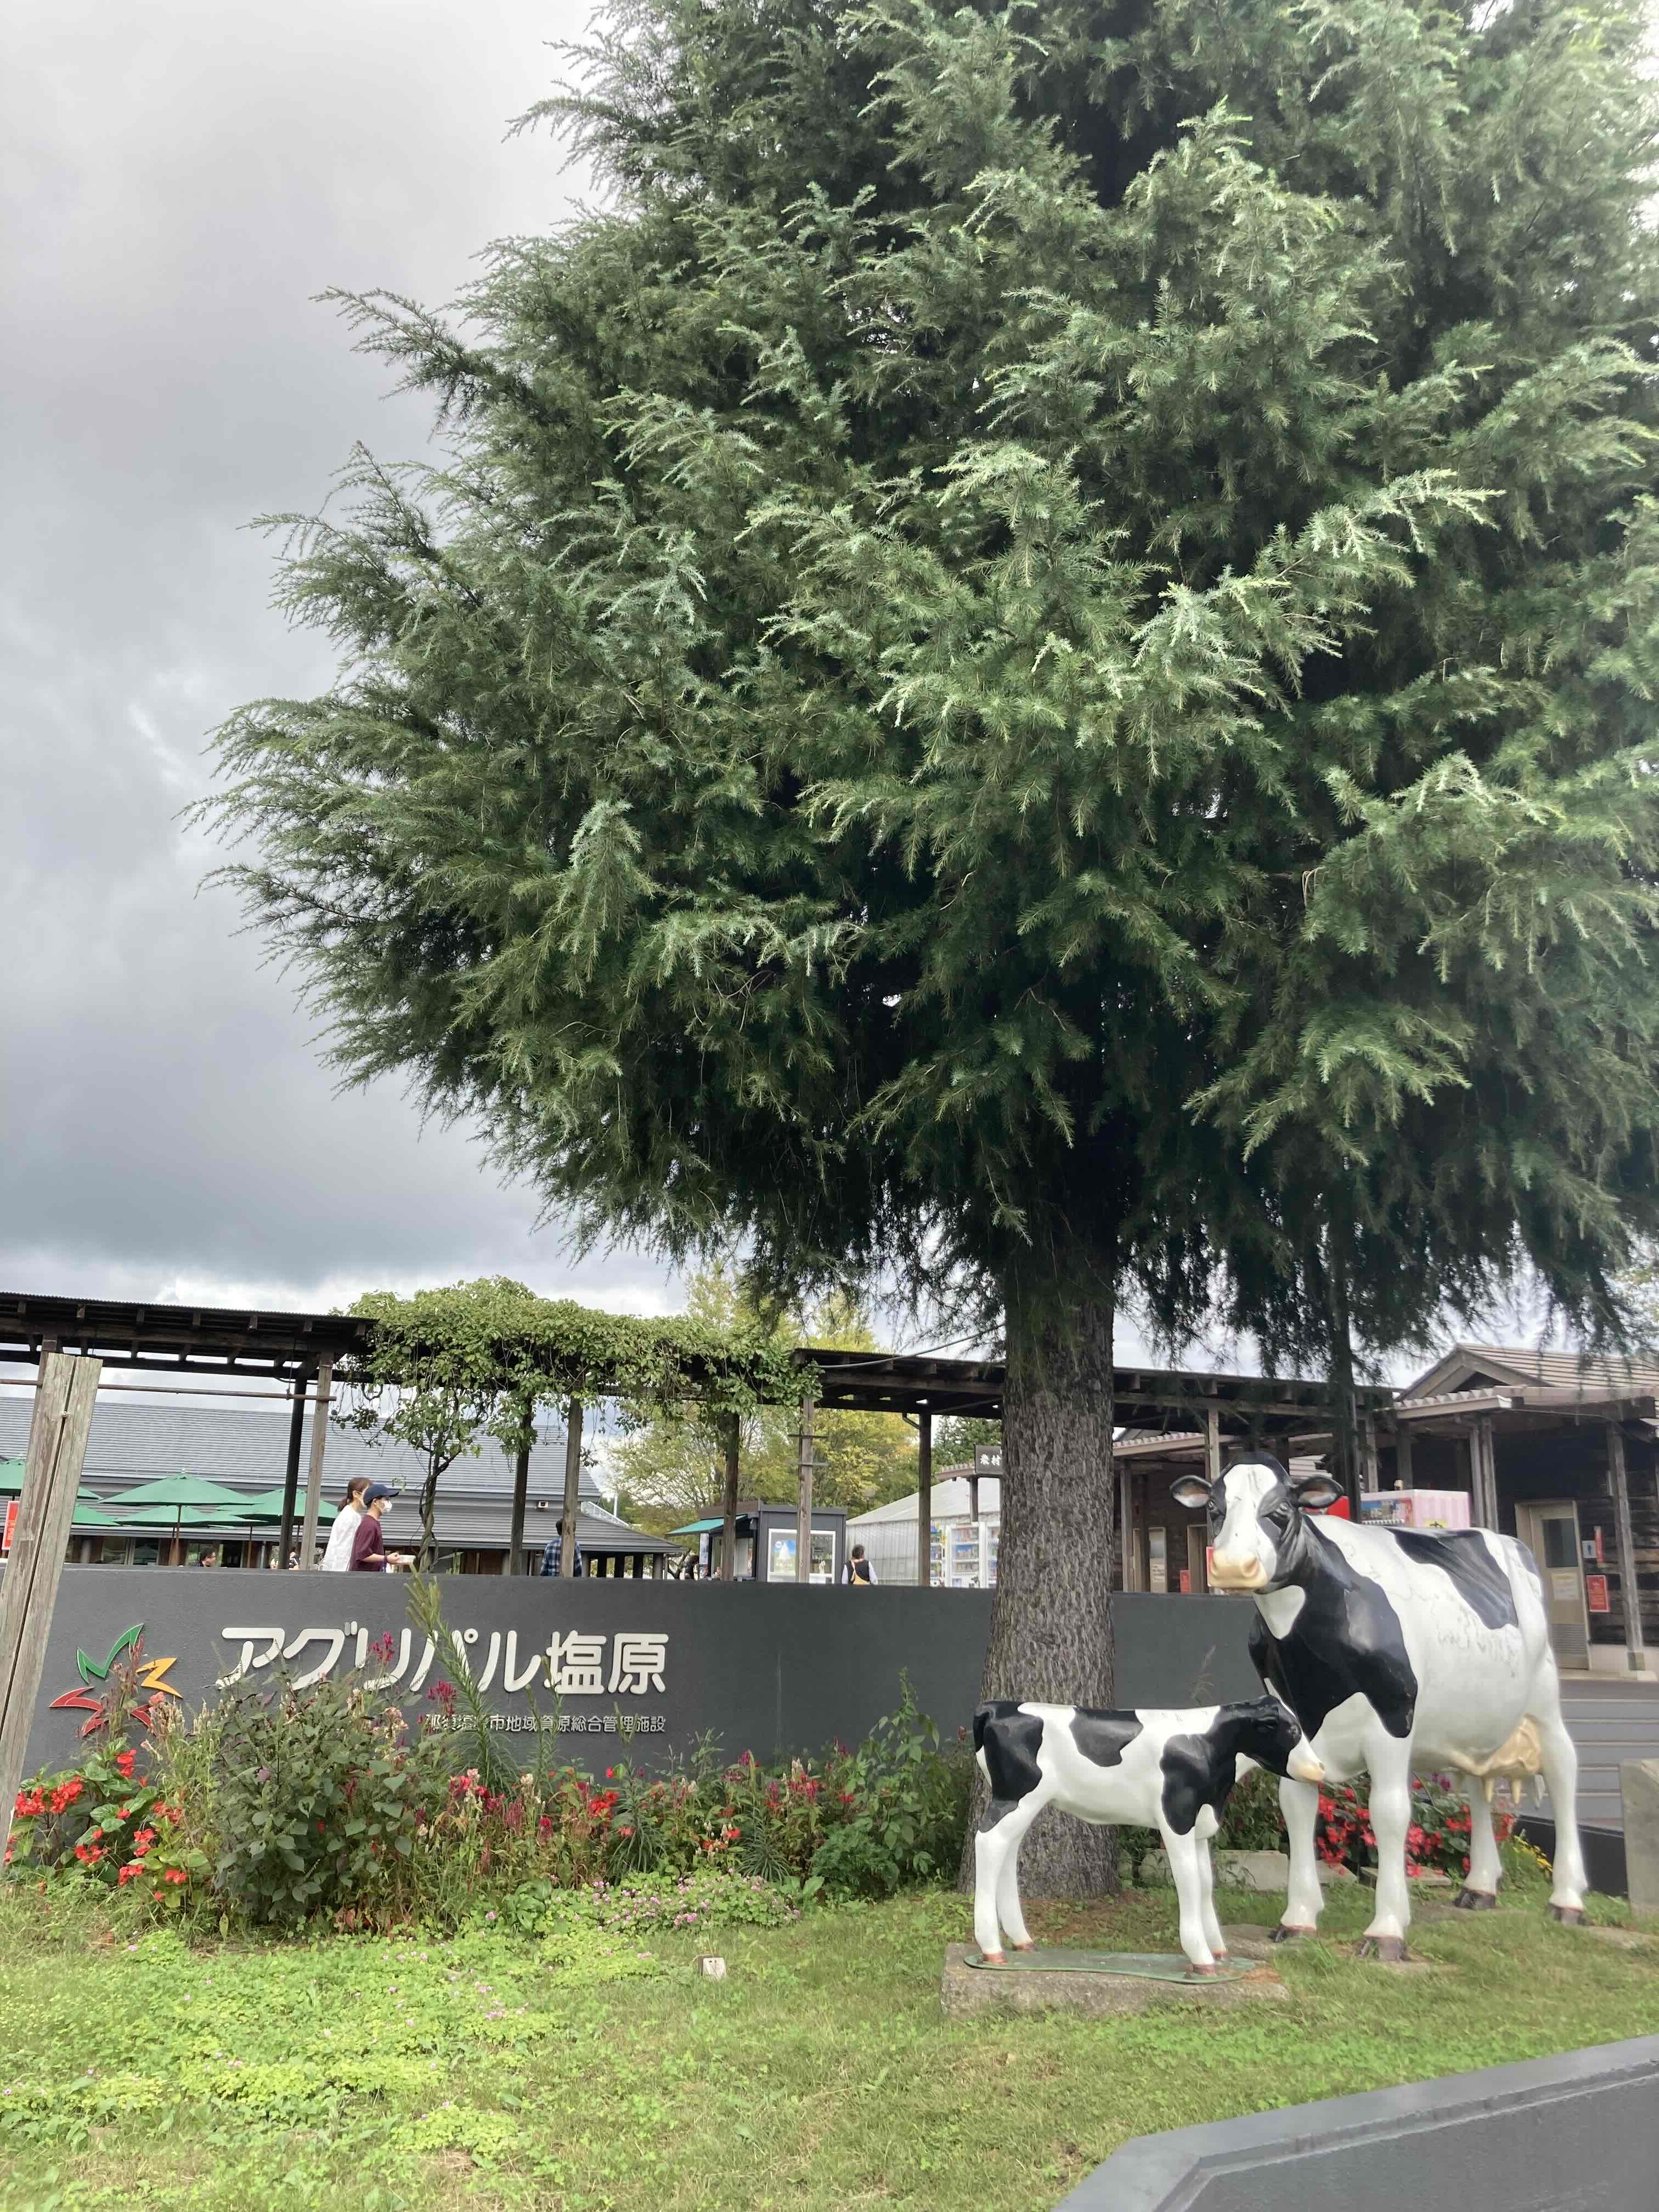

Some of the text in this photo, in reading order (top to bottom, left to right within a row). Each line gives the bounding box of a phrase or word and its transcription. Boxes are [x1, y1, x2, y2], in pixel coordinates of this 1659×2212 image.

[216, 1621, 669, 1695] アグリパル塩原
